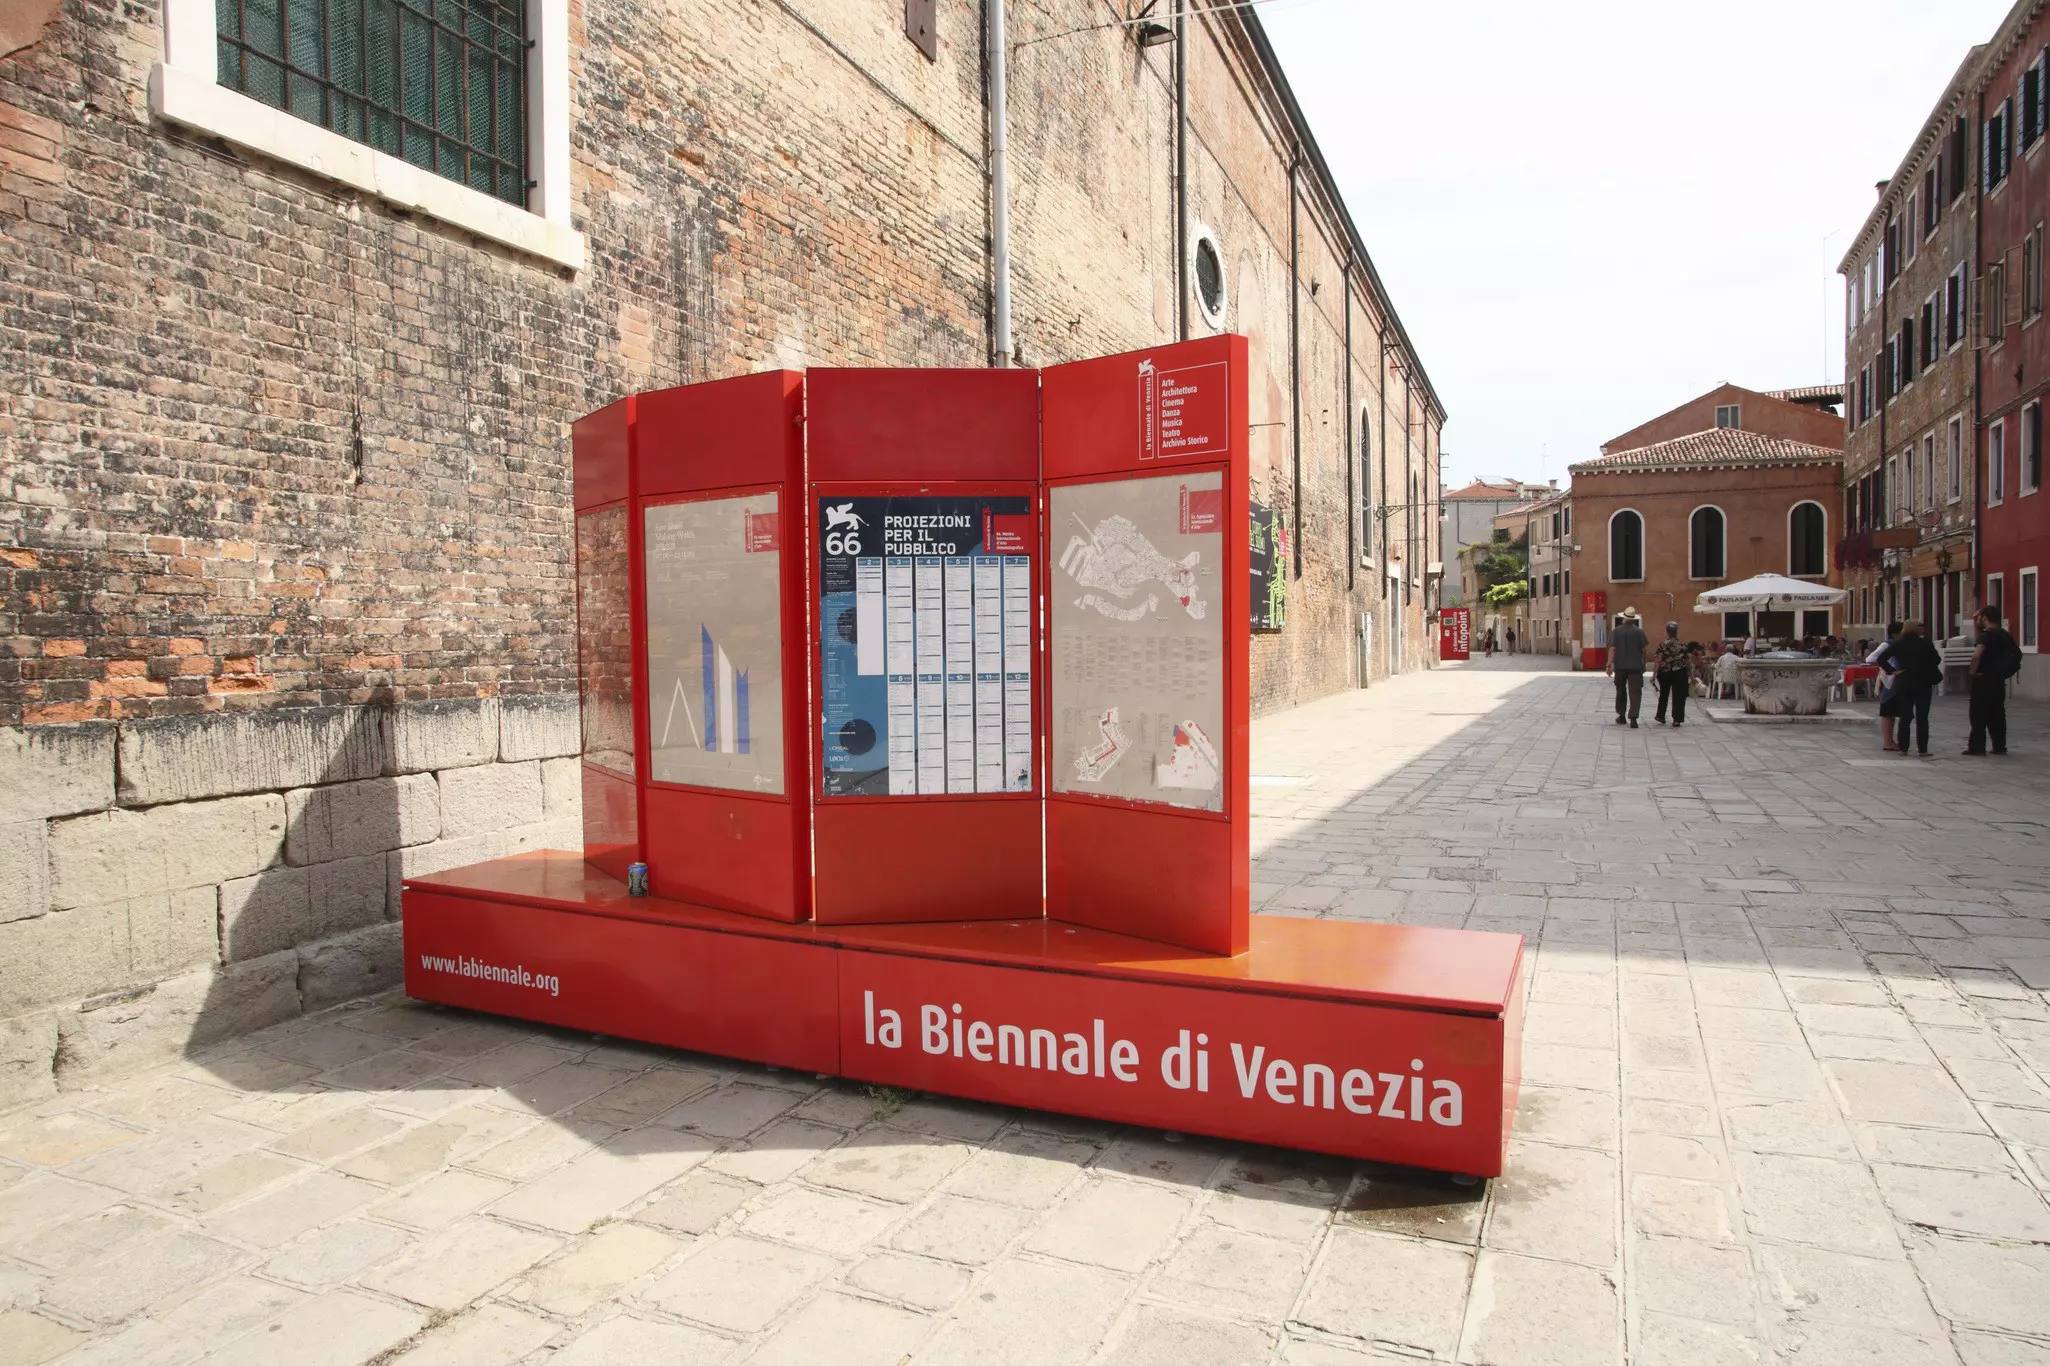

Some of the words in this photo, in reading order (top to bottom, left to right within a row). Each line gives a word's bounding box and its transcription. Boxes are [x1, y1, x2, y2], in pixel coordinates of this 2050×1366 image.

[1162, 379, 1175, 388] Arte
[1162, 386, 1198, 398] Architettura
[1145, 404, 1152, 412] di
[1162, 398, 1185, 408] Cinema
[1162, 409, 1181, 418] Danza
[1162, 418, 1183, 428] Musica
[1162, 429, 1181, 438] Teatro
[1145, 443, 1152, 451] la
[1162, 438, 1187, 449] Archivio
[1187, 436, 1209, 446] Storico
[884, 515, 971, 528] PROIEZIONI
[884, 529, 913, 541] PER
[918, 529, 934, 541] IL
[826, 532, 862, 556] 66
[884, 543, 957, 555] PUBBLICO
[1457, 611, 1470, 653] infopoint
[420, 954, 561, 997] www.labiennale.org
[864, 990, 902, 1049] la
[921, 1003, 1139, 1082] Biennale
[1161, 1028, 1210, 1093] di
[1230, 1042, 1463, 1127] Venezia
